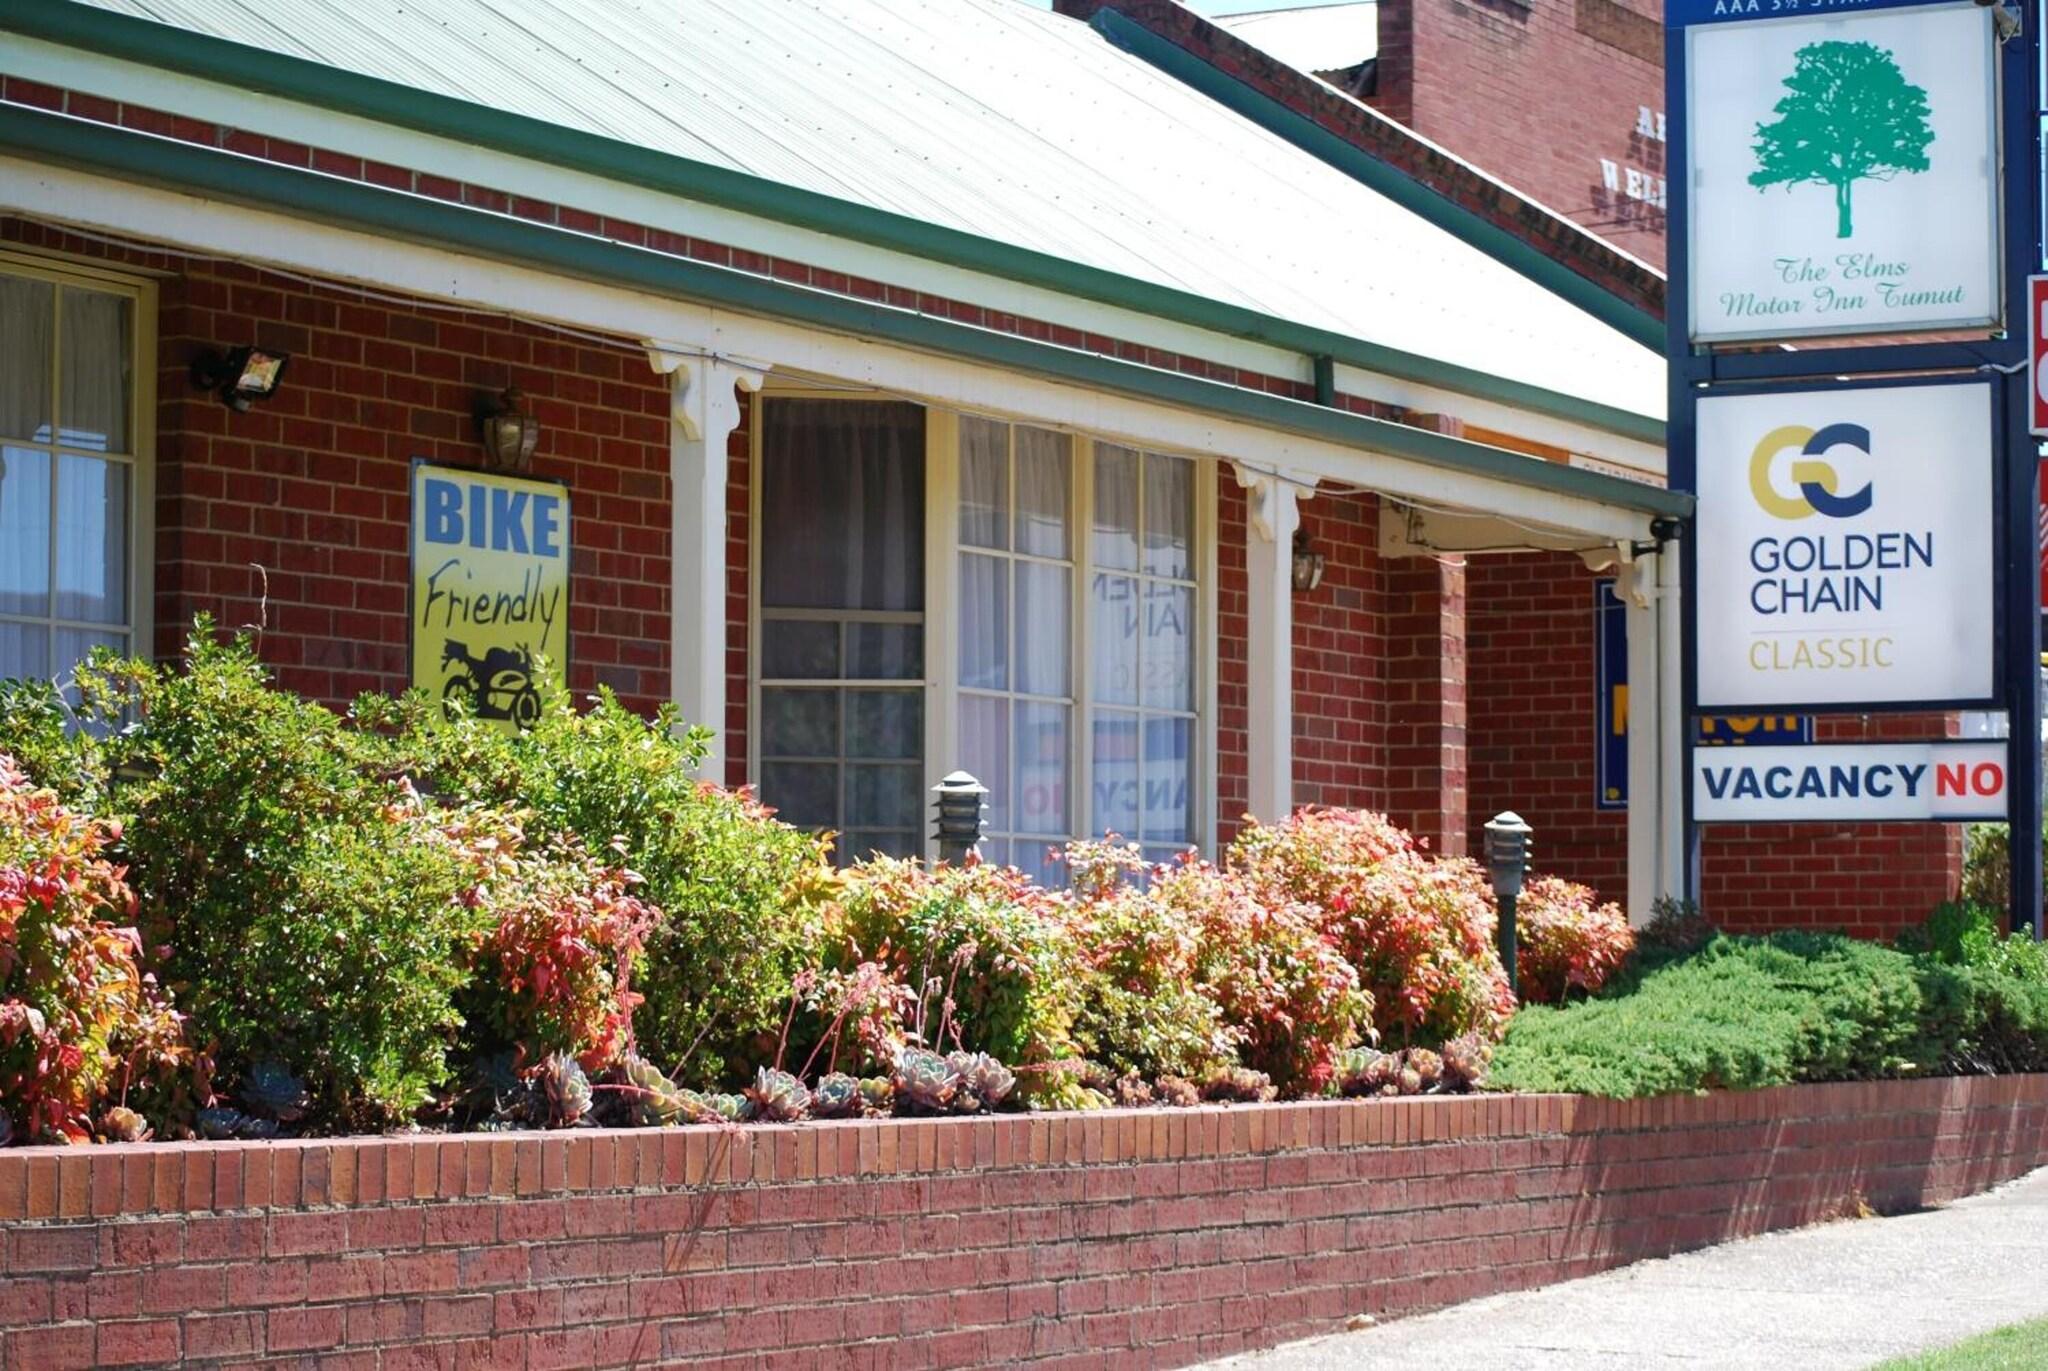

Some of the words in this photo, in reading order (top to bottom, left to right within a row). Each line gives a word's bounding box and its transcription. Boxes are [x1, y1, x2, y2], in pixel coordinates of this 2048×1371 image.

[1774, 257, 1829, 284] The
[1835, 253, 1909, 280] Elms
[1719, 292, 1801, 318] Motor
[1812, 286, 1867, 313] Inn
[1875, 282, 1966, 309] Tumut
[424, 478, 560, 557] BIKE
[1750, 531, 1933, 574] GOLDEN
[423, 559, 560, 651] Friendly
[1750, 576, 1883, 615] CHAIN
[1748, 637, 1894, 672] CLASSIC
[1702, 763, 1927, 799] VACANCY
[1936, 762, 2004, 797] NO
